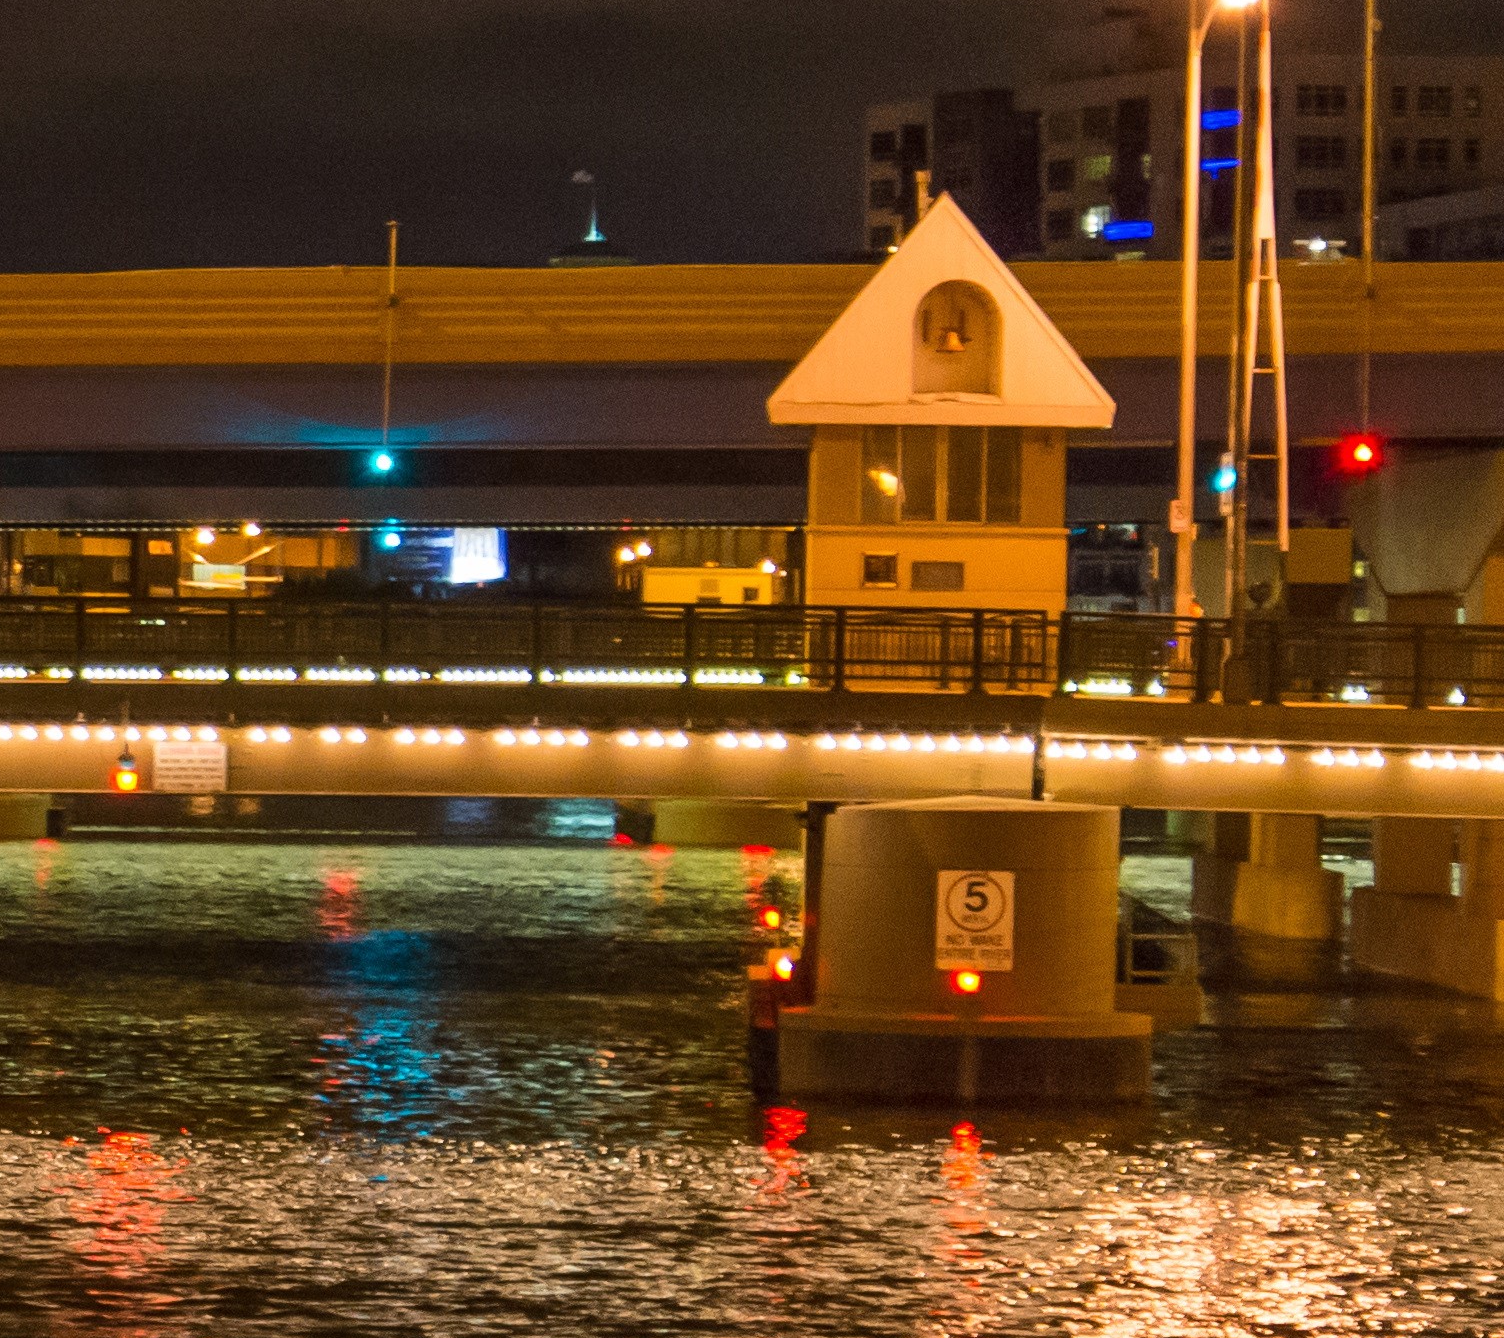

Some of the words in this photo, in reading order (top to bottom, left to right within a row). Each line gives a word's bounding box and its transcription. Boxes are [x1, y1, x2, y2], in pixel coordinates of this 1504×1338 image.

[964, 880, 989, 913] 5
[946, 934, 964, 945] NO
[970, 934, 1004, 946] WAKE
[937, 947, 976, 960] ENTIRE
